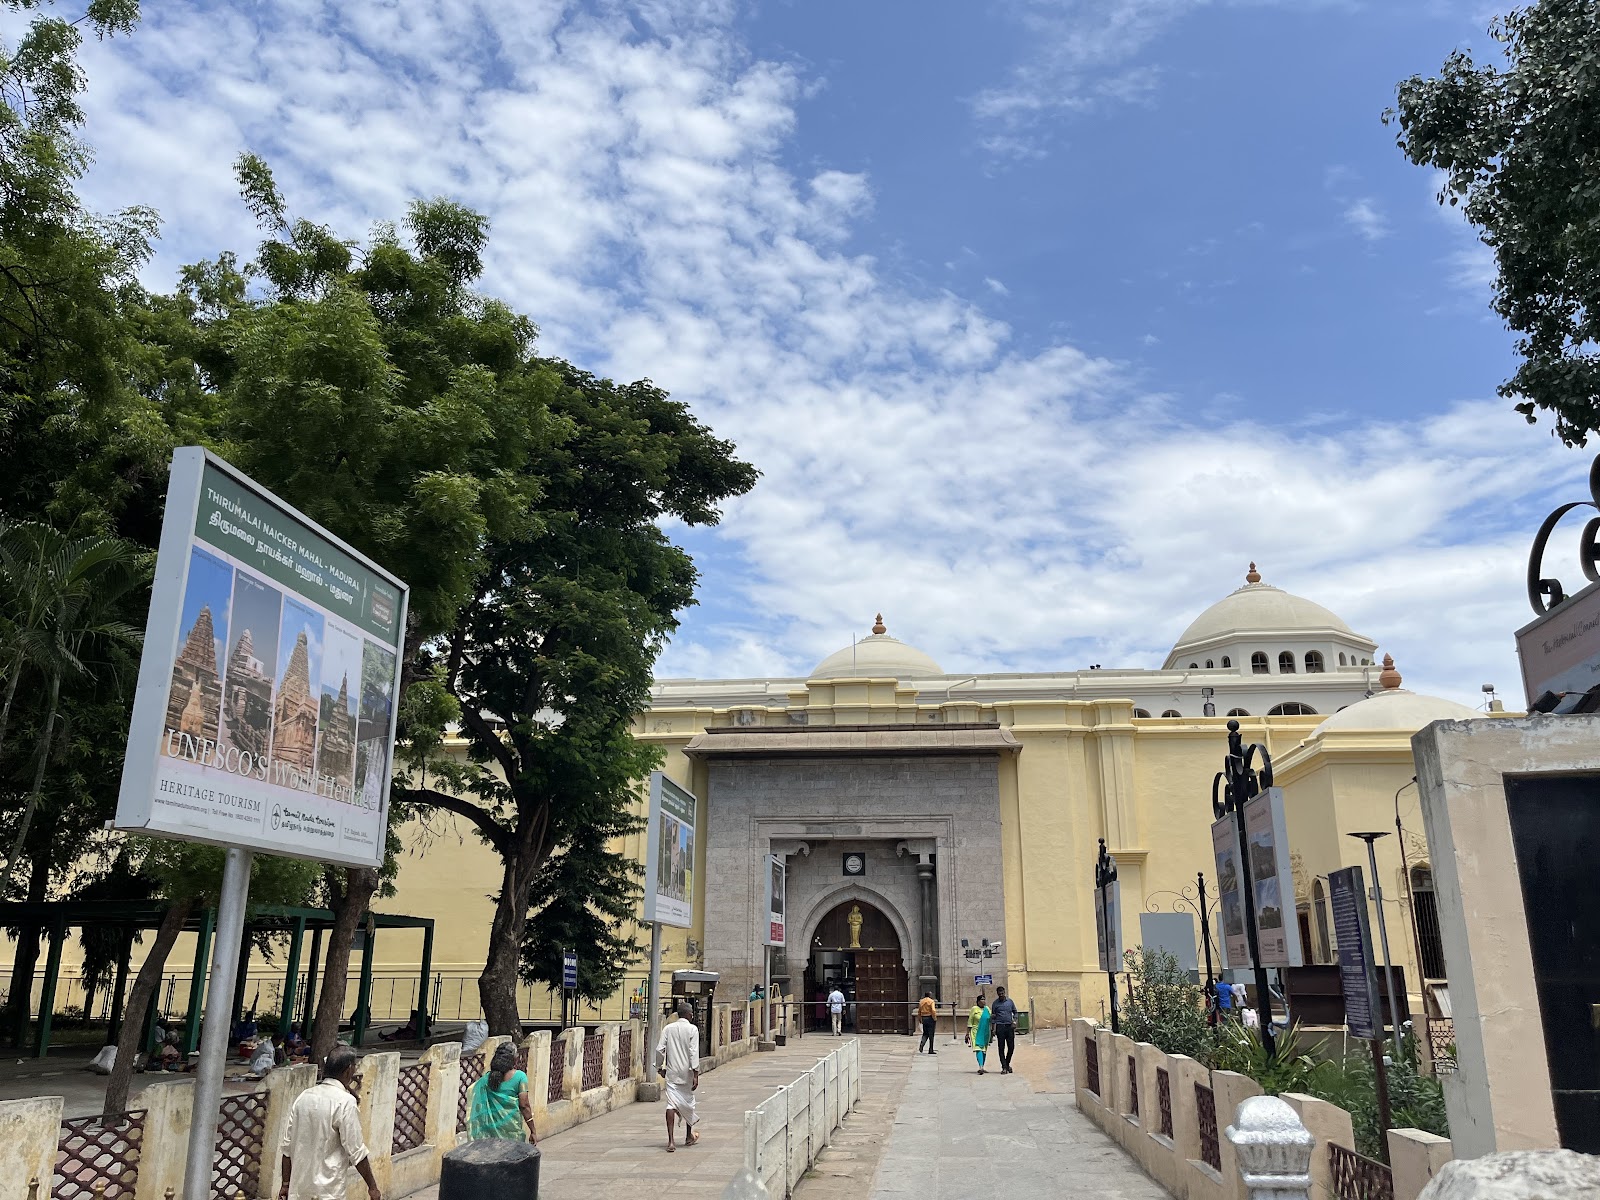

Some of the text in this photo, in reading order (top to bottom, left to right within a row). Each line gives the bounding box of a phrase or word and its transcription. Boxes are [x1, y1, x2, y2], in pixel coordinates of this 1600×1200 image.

[207, 488, 261, 530] THIRUMALAI
[263, 523, 298, 552] NAICKER
[299, 545, 323, 569] MAHAL
[329, 564, 360, 592] MADURAI
[208, 510, 255, 546] திருமலை
[256, 540, 294, 569] நாயக்கர்
[295, 563, 323, 586] மஹால்
[329, 583, 354, 605] மதுரை
[160, 779, 261, 811] HERITAGE TOURISM
[167, 728, 377, 815] UNESCO'S World Heritage
